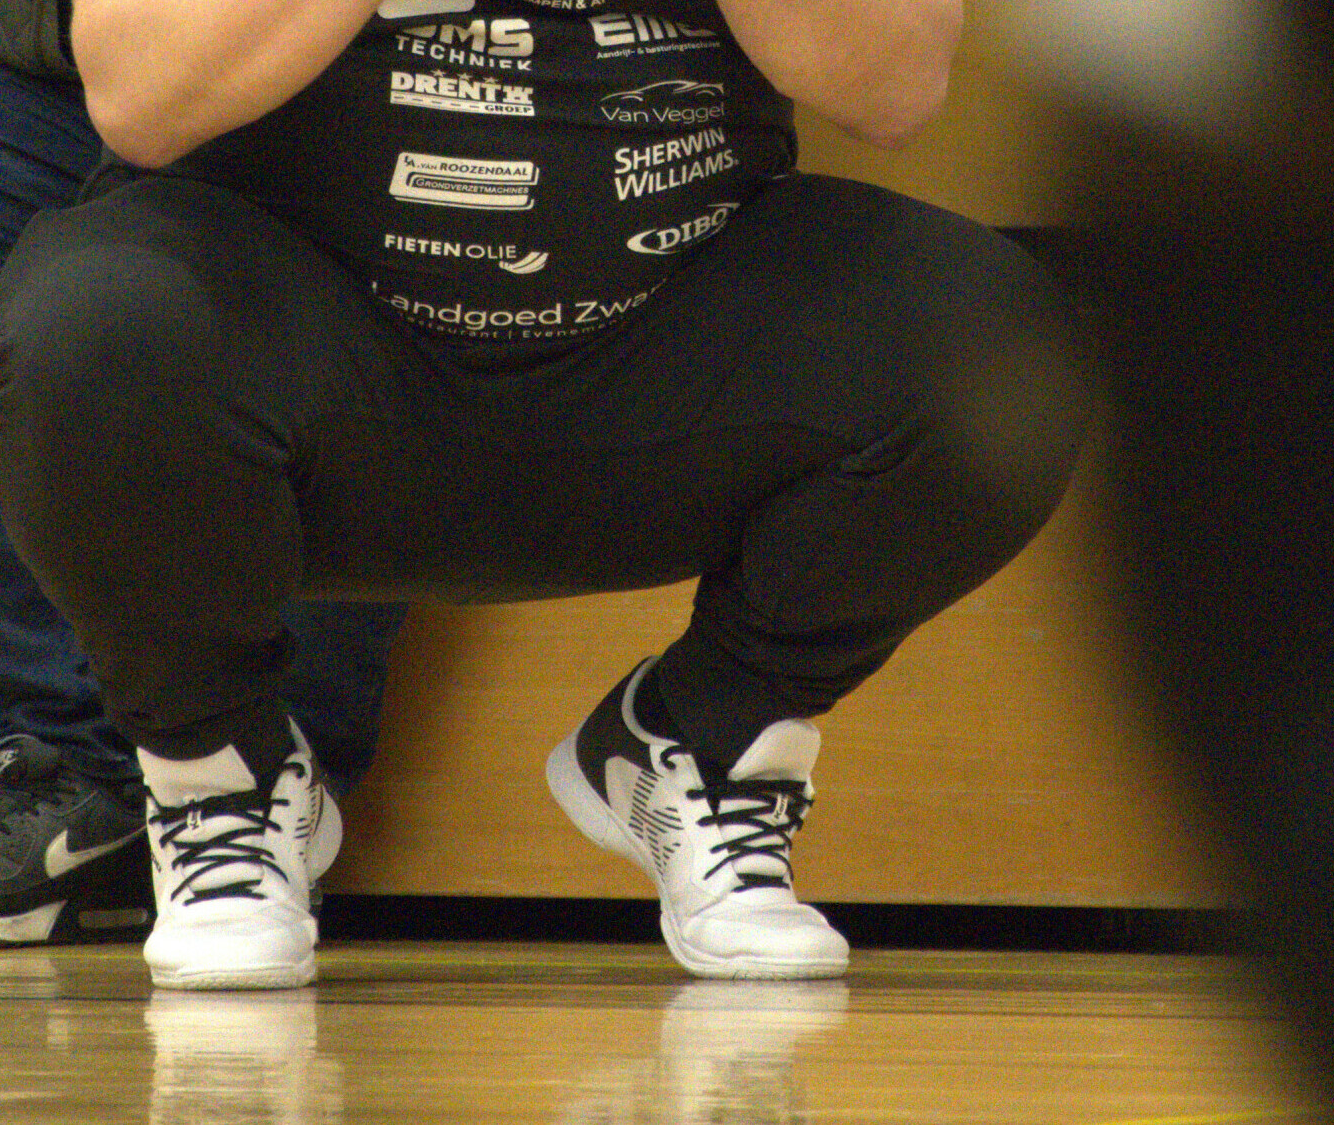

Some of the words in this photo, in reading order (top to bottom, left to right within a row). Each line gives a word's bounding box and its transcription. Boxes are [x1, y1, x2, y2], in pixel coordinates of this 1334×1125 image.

[395, 35, 533, 72] TECHNIEK
[484, 104, 533, 115] GROEP
[600, 106, 649, 123] Van
[652, 102, 725, 125] Veggel
[614, 127, 726, 174] SHERWIN
[439, 162, 529, 176] ROOZENDAAL
[415, 177, 530, 195] GRONDVERZETMACHINES
[656, 207, 728, 251] DIBO
[384, 233, 461, 257] FIETEN
[465, 244, 517, 259] OLIE
